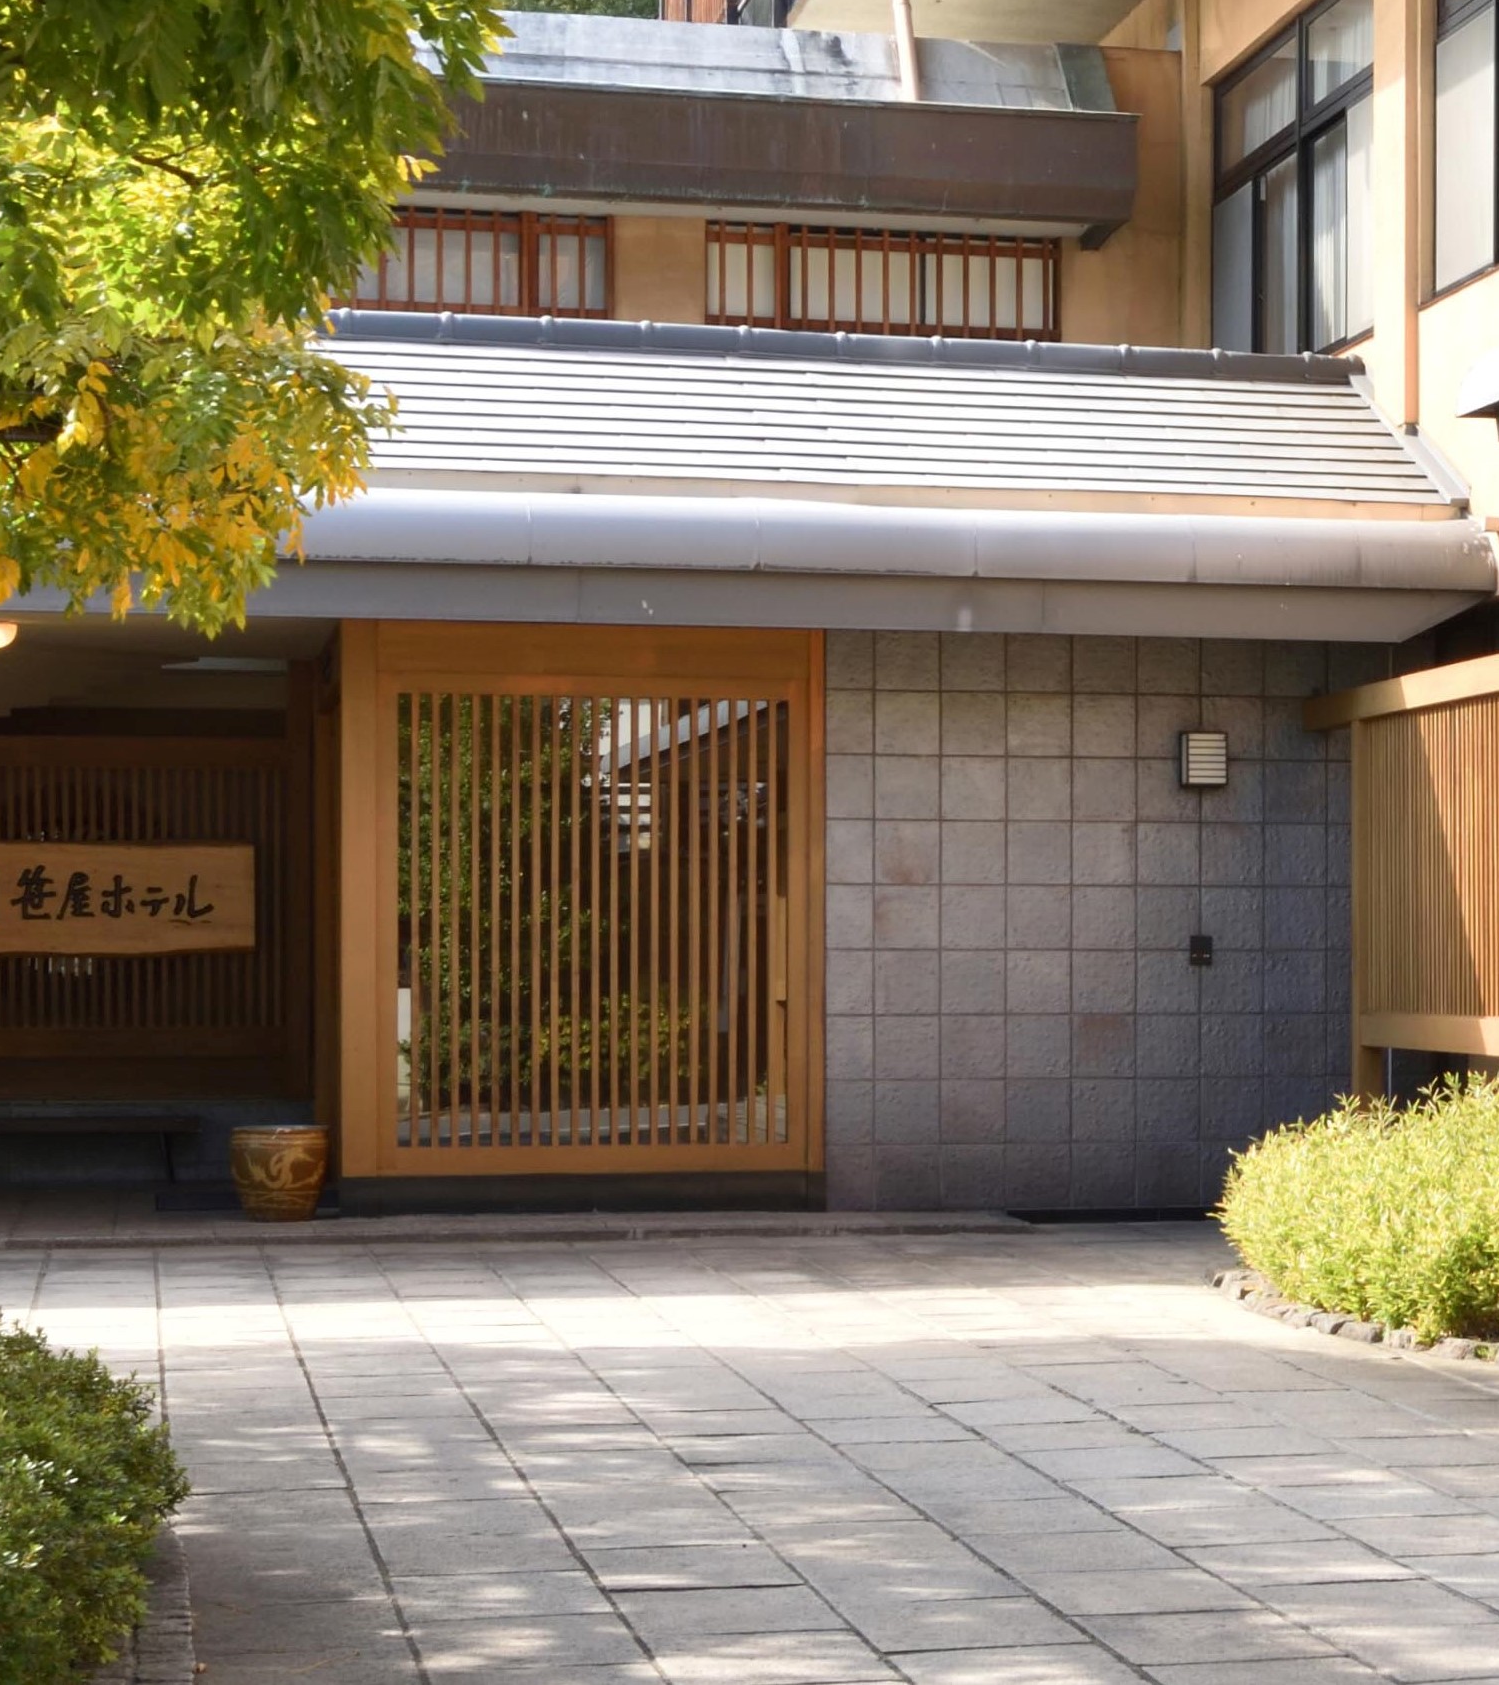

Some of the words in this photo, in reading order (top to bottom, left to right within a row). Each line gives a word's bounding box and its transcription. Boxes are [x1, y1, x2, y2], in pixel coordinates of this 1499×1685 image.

[10, 864, 215, 920] 笹屋ホテル
